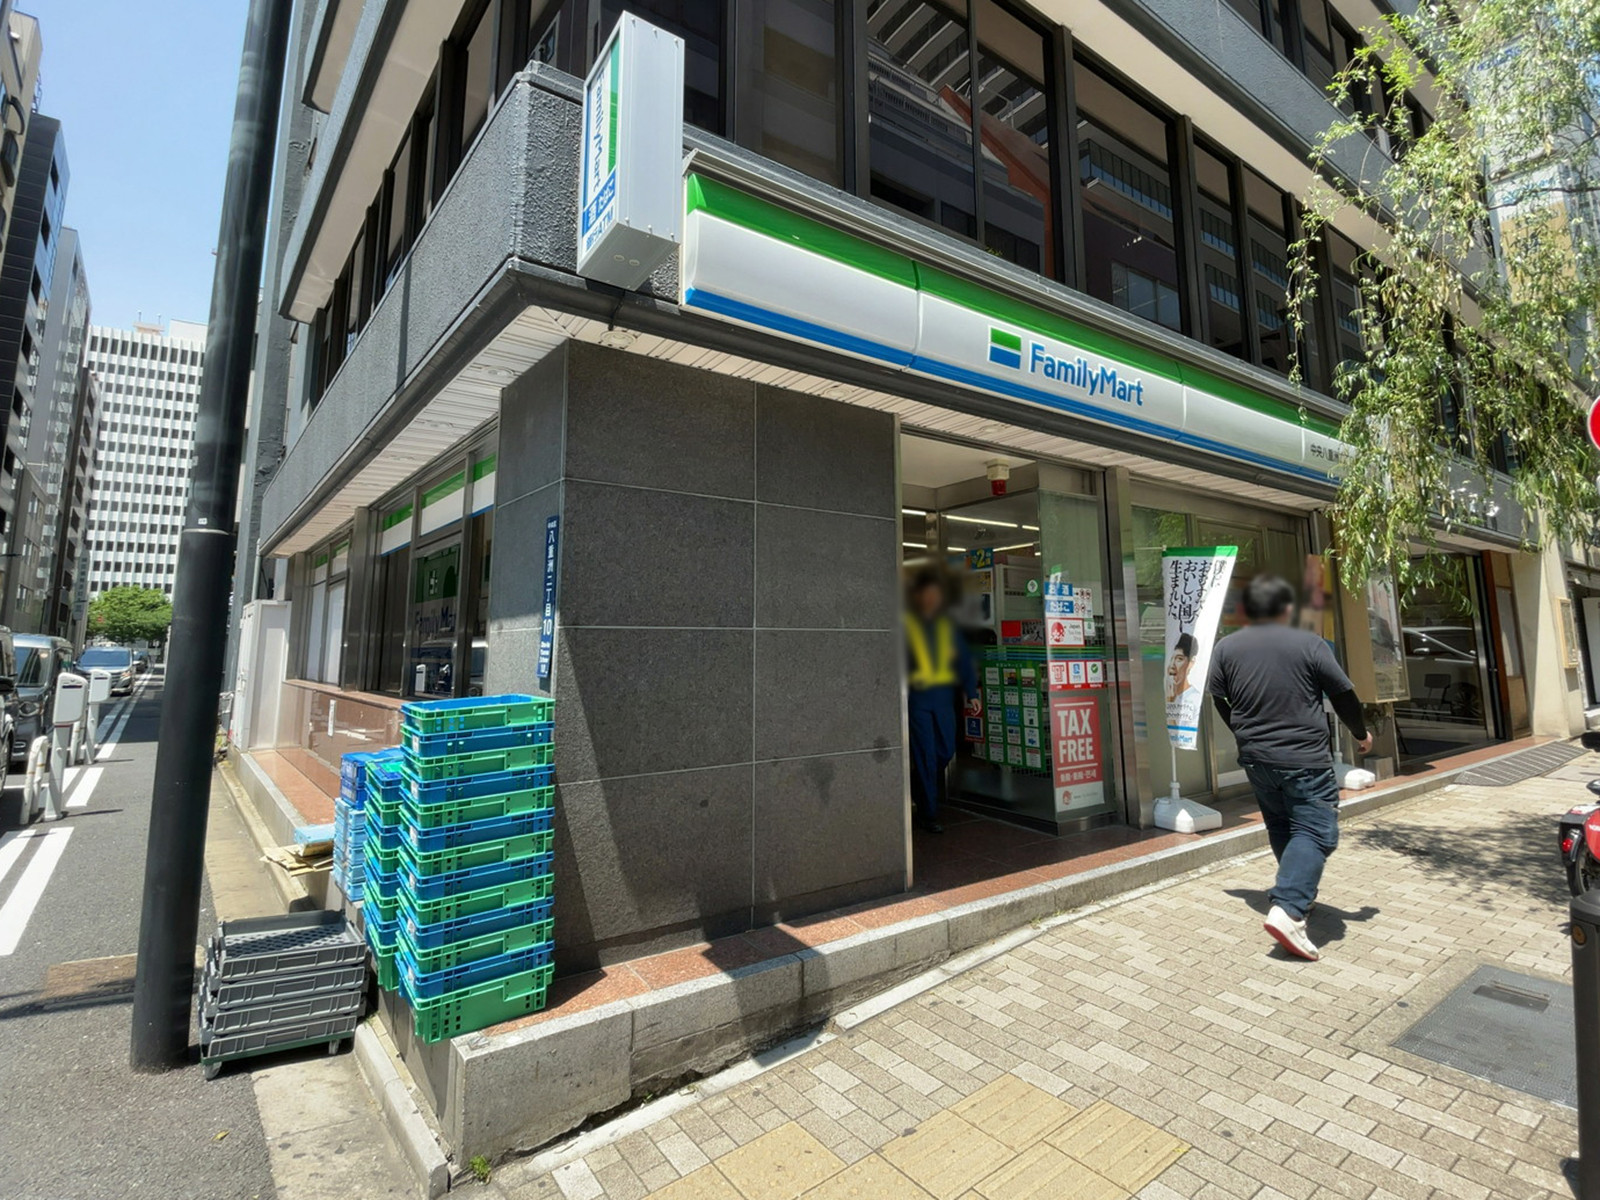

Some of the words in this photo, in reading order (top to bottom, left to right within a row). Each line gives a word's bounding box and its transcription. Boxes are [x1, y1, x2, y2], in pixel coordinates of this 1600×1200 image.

[593, 71, 605, 192] FamilyMart
[1030, 341, 1144, 406] FamilyMart
[1050, 602, 1070, 612] たばこ
[543, 618, 553, 636] 10
[1057, 709, 1092, 737] TAX
[1059, 738, 1094, 763] FREE
